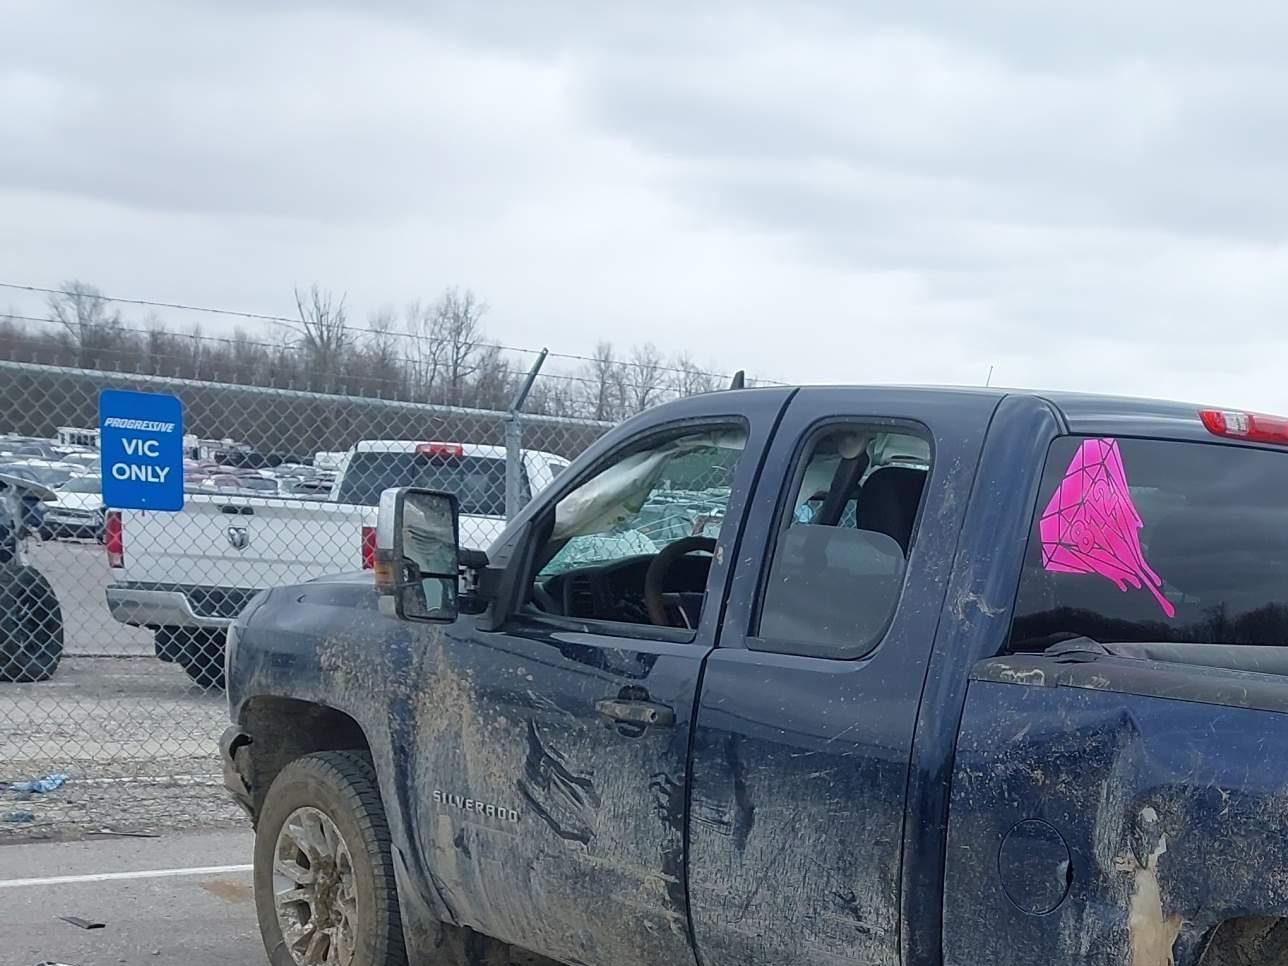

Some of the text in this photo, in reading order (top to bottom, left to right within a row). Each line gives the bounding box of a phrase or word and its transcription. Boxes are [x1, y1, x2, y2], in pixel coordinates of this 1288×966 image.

[104, 417, 176, 433] PROGRESSIVE
[121, 437, 160, 457] VIC
[111, 462, 170, 483] ONLY
[432, 790, 519, 823] SILVERADO
